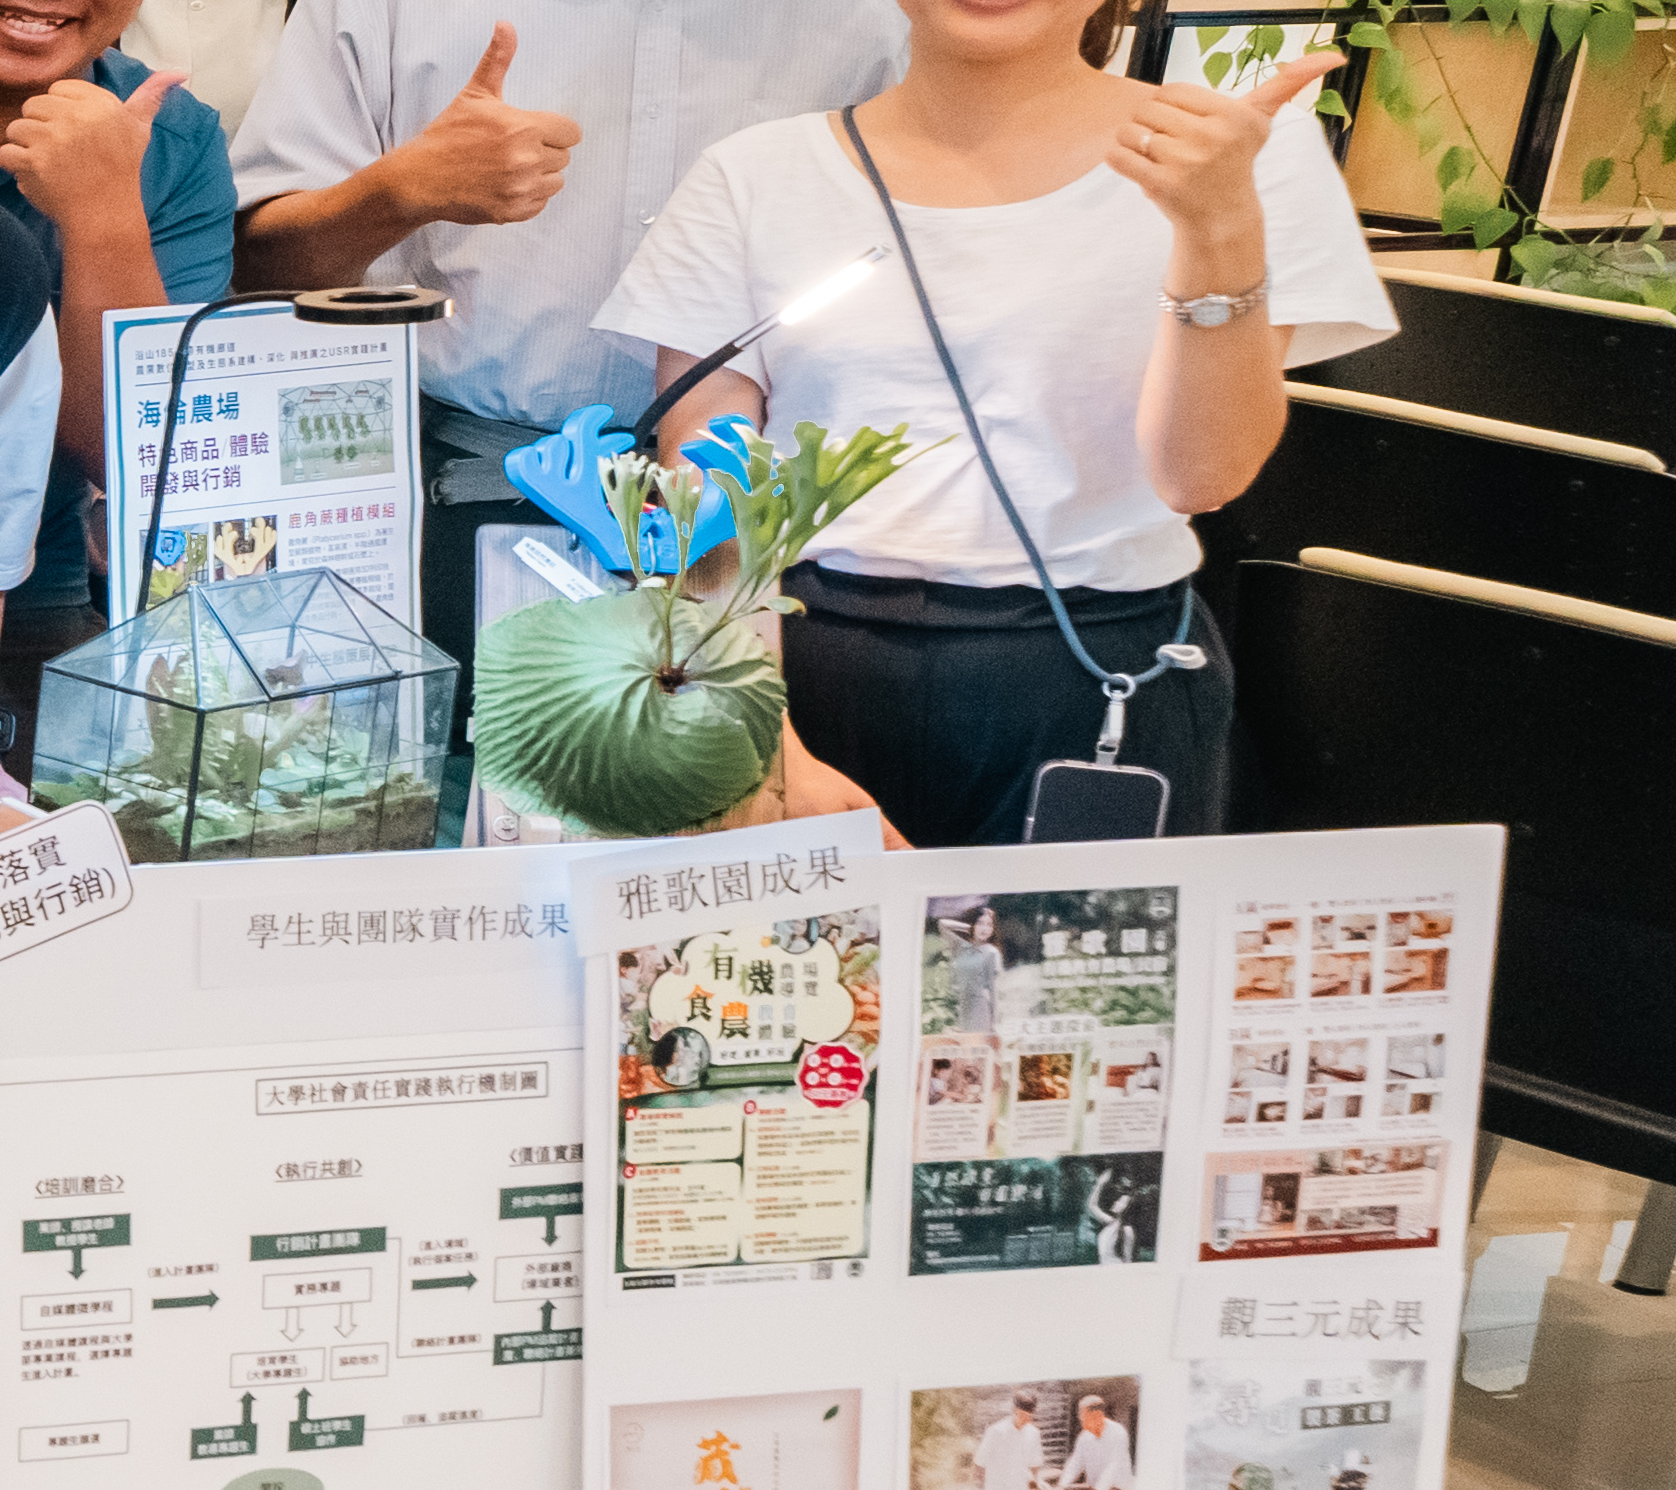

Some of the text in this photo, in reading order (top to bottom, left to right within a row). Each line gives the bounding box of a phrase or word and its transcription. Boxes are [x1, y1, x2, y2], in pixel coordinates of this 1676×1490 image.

[615, 847, 846, 920] 雅歌園成果
[245, 902, 570, 950] 學生與團隊實作成果
[1219, 1297, 1425, 1345] 觀三元成果
